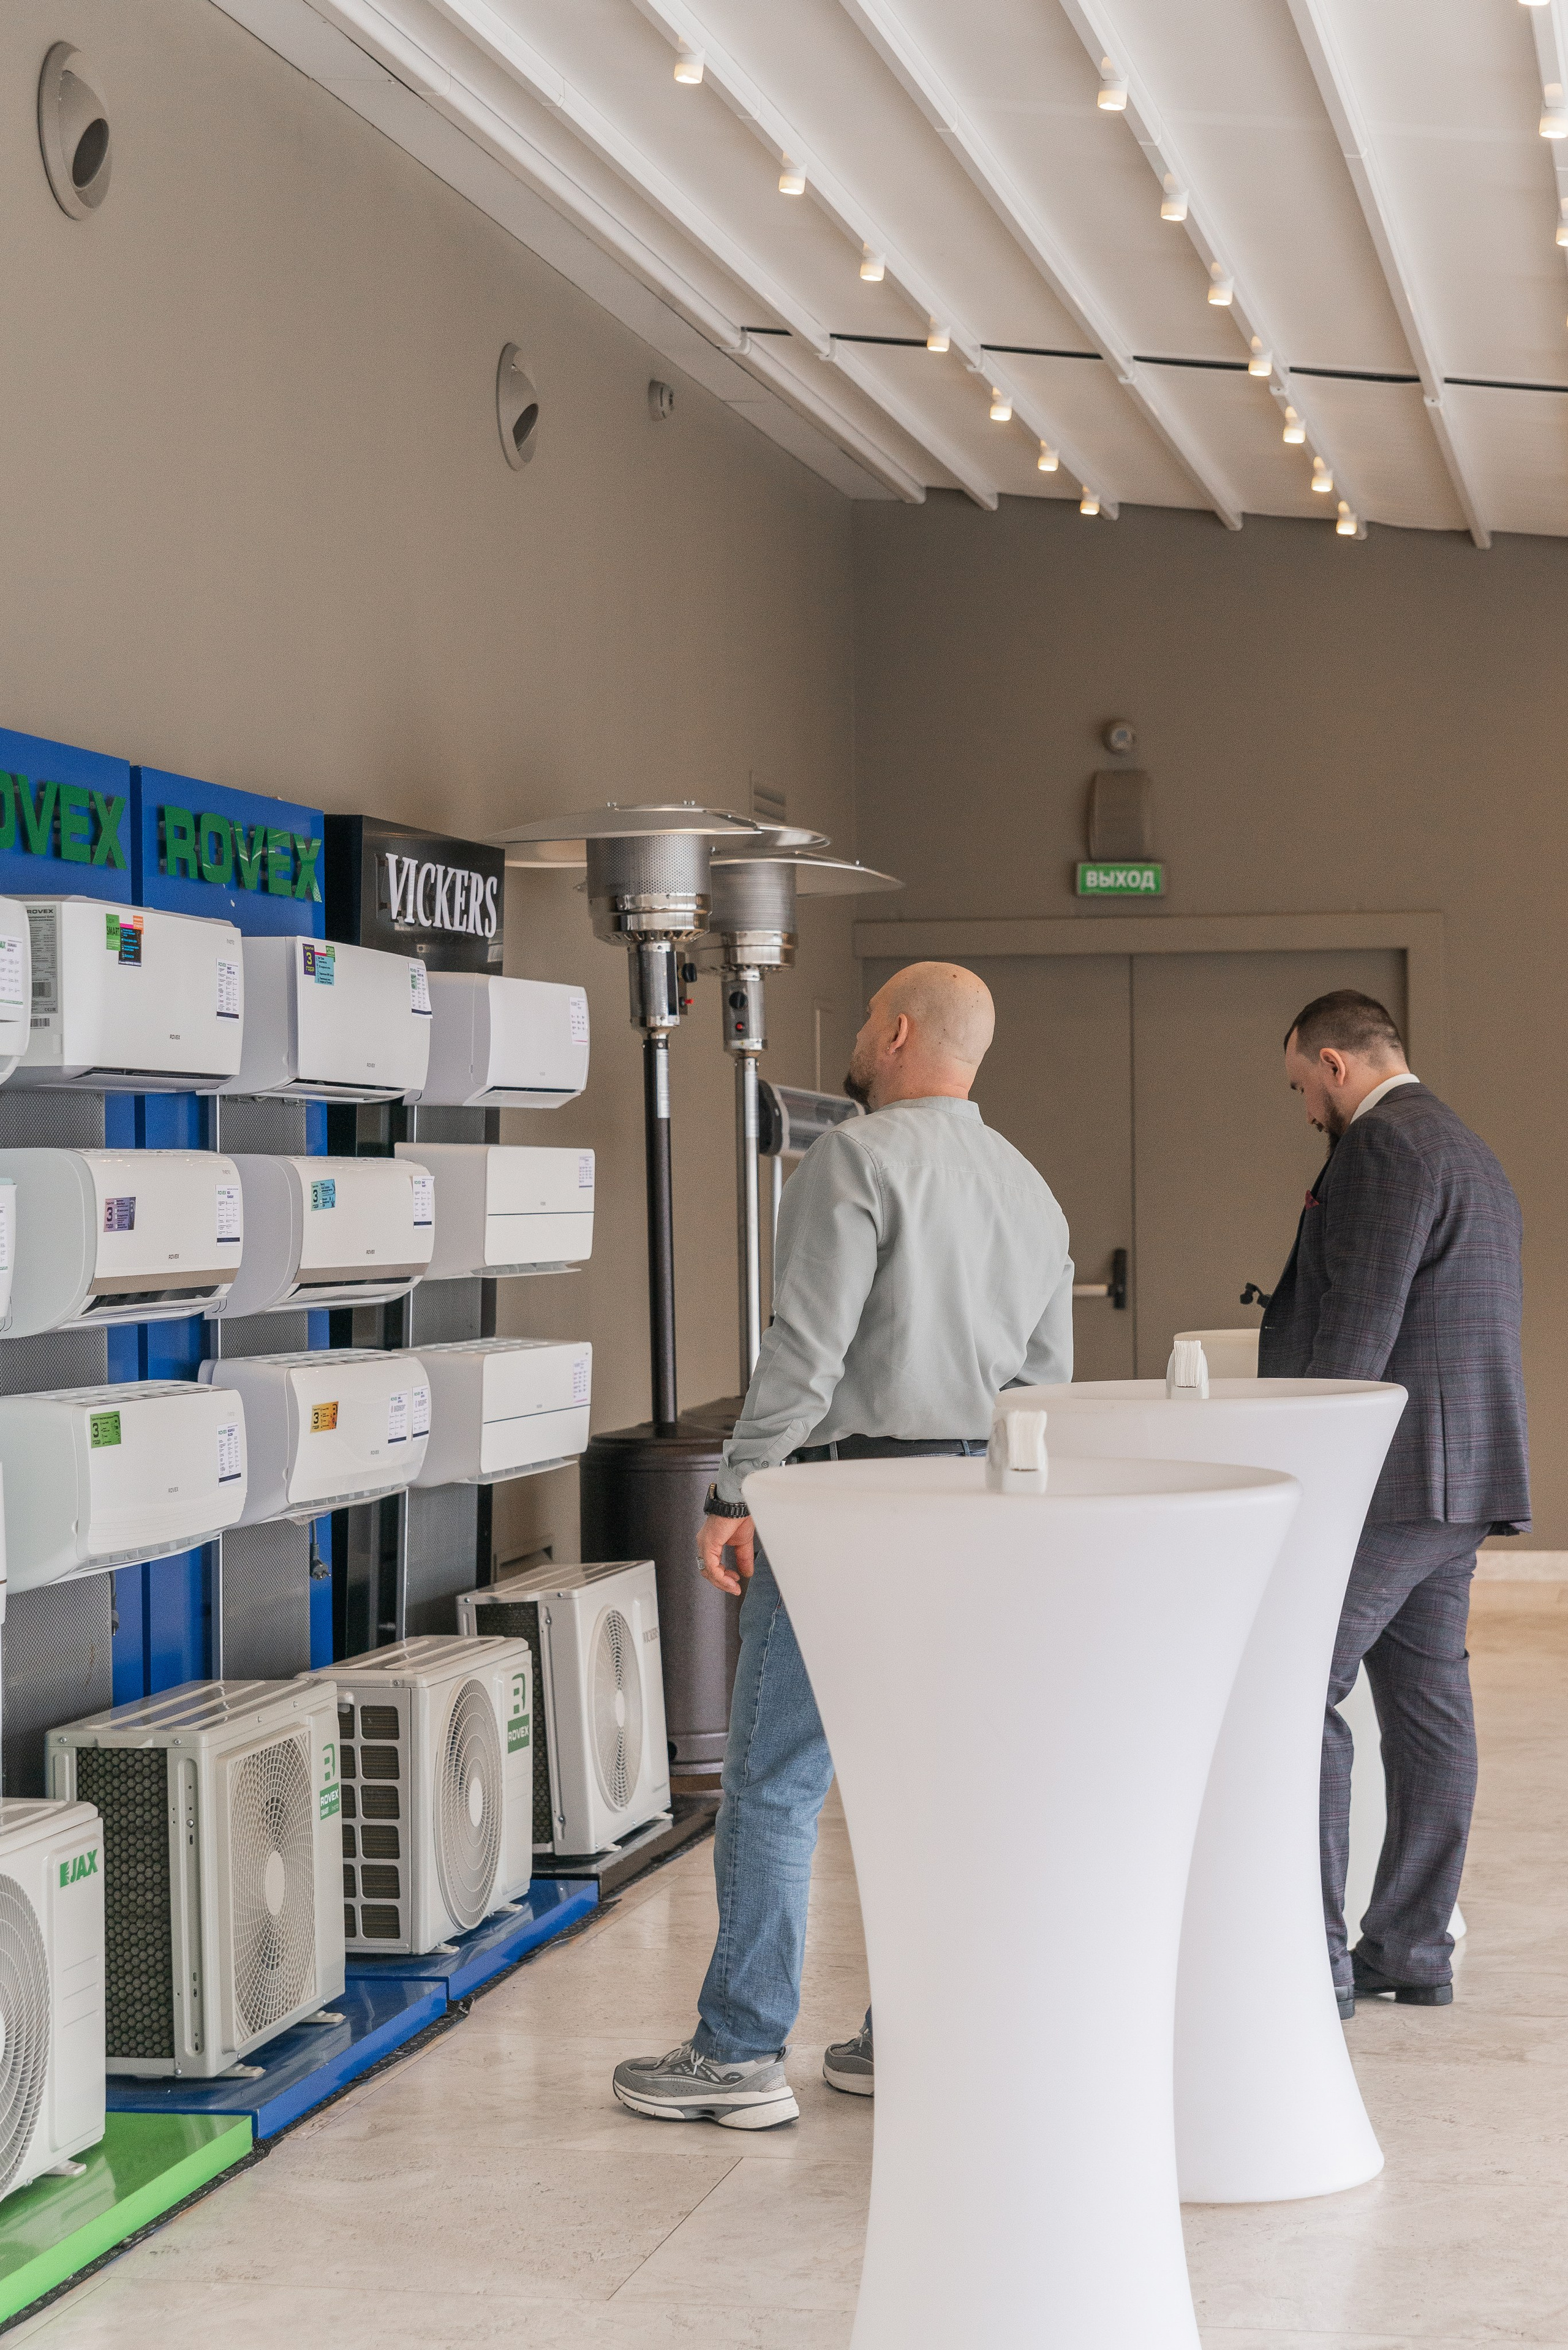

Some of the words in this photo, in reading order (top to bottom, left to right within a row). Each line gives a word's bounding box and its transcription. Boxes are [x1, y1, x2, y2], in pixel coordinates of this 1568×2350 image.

[164, 805, 322, 903] ROVEX
[1086, 870, 1155, 891] ВЫХОД
[385, 853, 498, 938] VICKERS
[306, 952, 312, 965] 3
[313, 1189, 318, 1203] 3
[107, 1207, 113, 1222] 3
[314, 1412, 319, 1424] 3
[92, 1422, 99, 1438] 3
[508, 1725, 529, 1742] ROVEX
[320, 1789, 339, 1807] ROVEX
